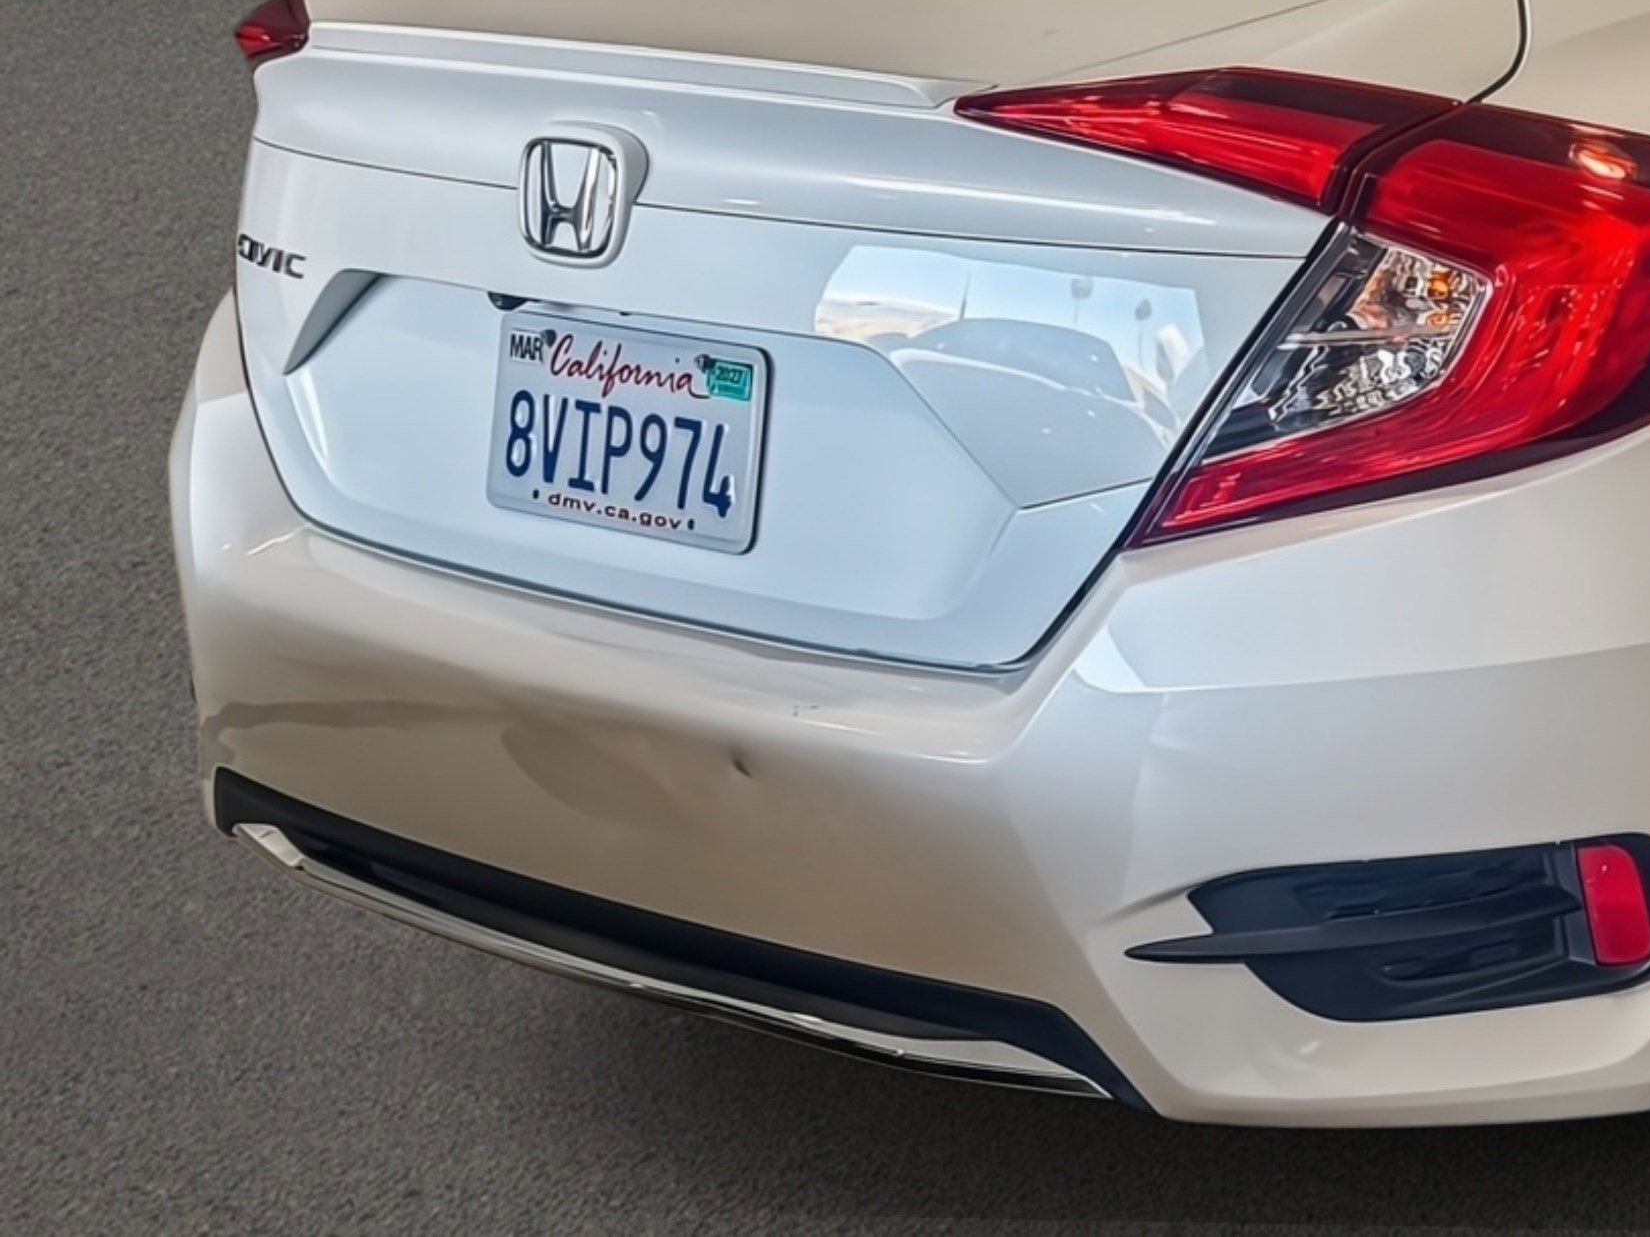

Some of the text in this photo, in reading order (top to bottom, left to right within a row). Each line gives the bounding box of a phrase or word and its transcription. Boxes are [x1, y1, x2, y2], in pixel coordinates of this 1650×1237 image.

[238, 233, 306, 279] CIVIC
[509, 332, 544, 362] MAR
[550, 333, 711, 400] California
[505, 389, 735, 518] 8VIP974
[547, 492, 682, 531] dmv.ca.gov
